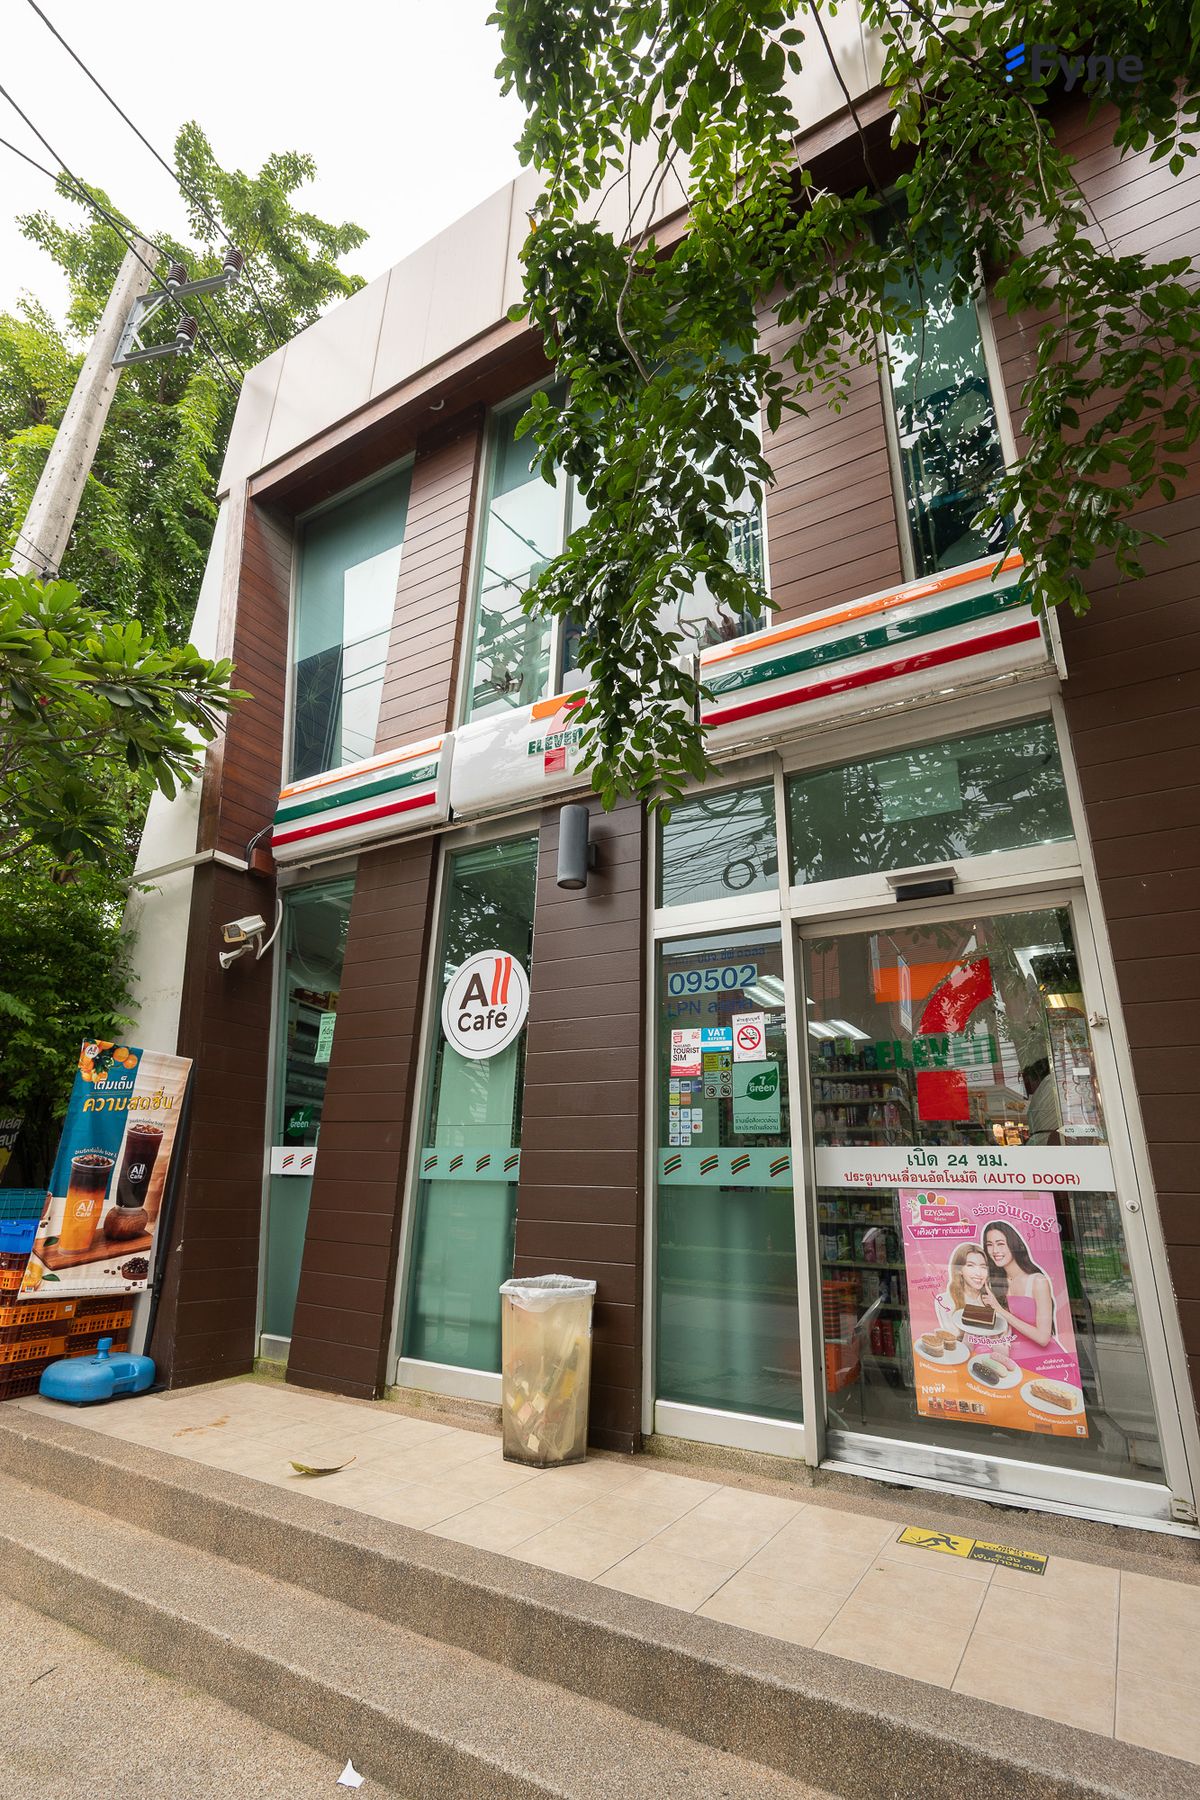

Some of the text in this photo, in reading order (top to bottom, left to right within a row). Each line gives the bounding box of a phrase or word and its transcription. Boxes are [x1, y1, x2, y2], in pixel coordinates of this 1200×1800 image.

[459, 956, 512, 1010] All
[669, 964, 757, 995] 09502
[667, 998, 701, 1018] LPN
[457, 1005, 508, 1032] Café
[707, 1028, 726, 1037] VAT
[672, 1054, 687, 1062] SIM
[673, 1047, 700, 1055] TOURIST
[82, 1085, 174, 1112] ความสดชื่น
[907, 1147, 1008, 1167] เปิด 24 ขม.
[843, 1167, 1081, 1186] ประตูบานเลื่อนอัตโนมัติ (AUTO DOOR)
[972, 1201, 1056, 1232] อร่อย อินเตอร์
